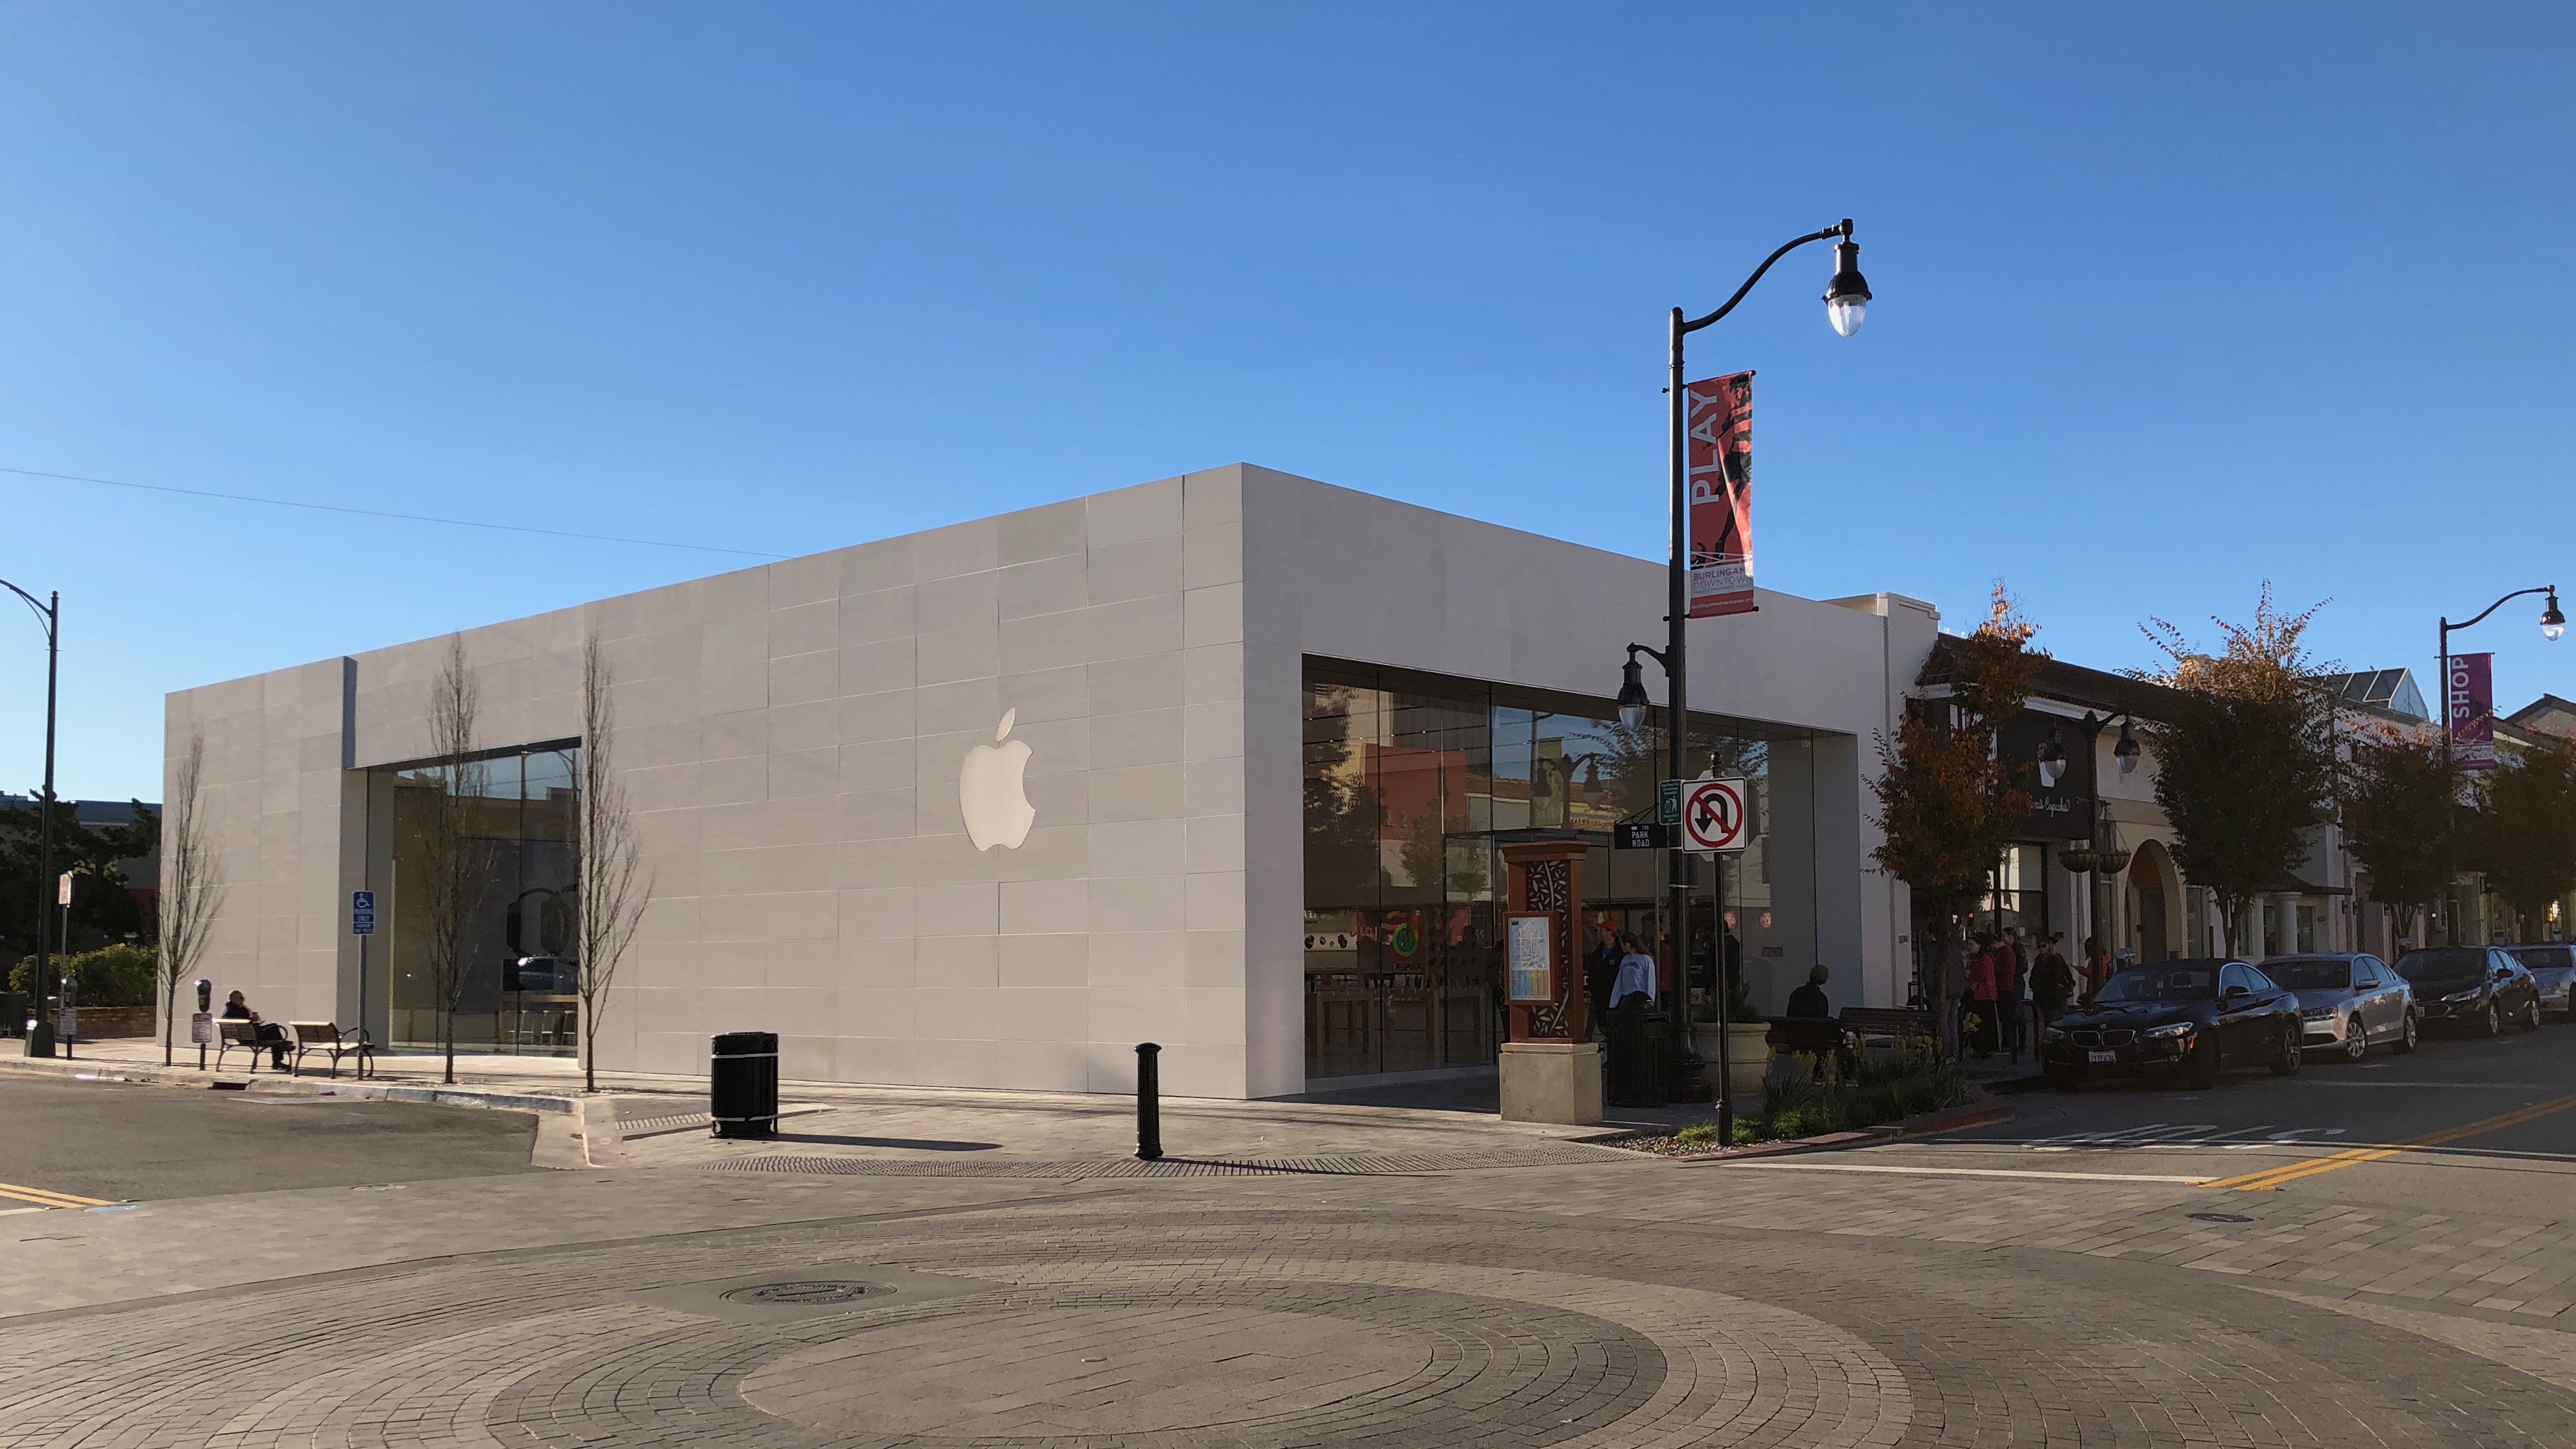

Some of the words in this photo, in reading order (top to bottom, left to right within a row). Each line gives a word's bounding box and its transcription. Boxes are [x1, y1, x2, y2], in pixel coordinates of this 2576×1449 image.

[1690, 390, 1718, 505] PLAY
[1693, 565, 1751, 581] BURLINGAME
[1693, 576, 1753, 589] DOWNTOWN
[2452, 657, 2470, 718] SHOP
[1631, 831, 1648, 839] PARK
[1632, 839, 1650, 847] ROAD
